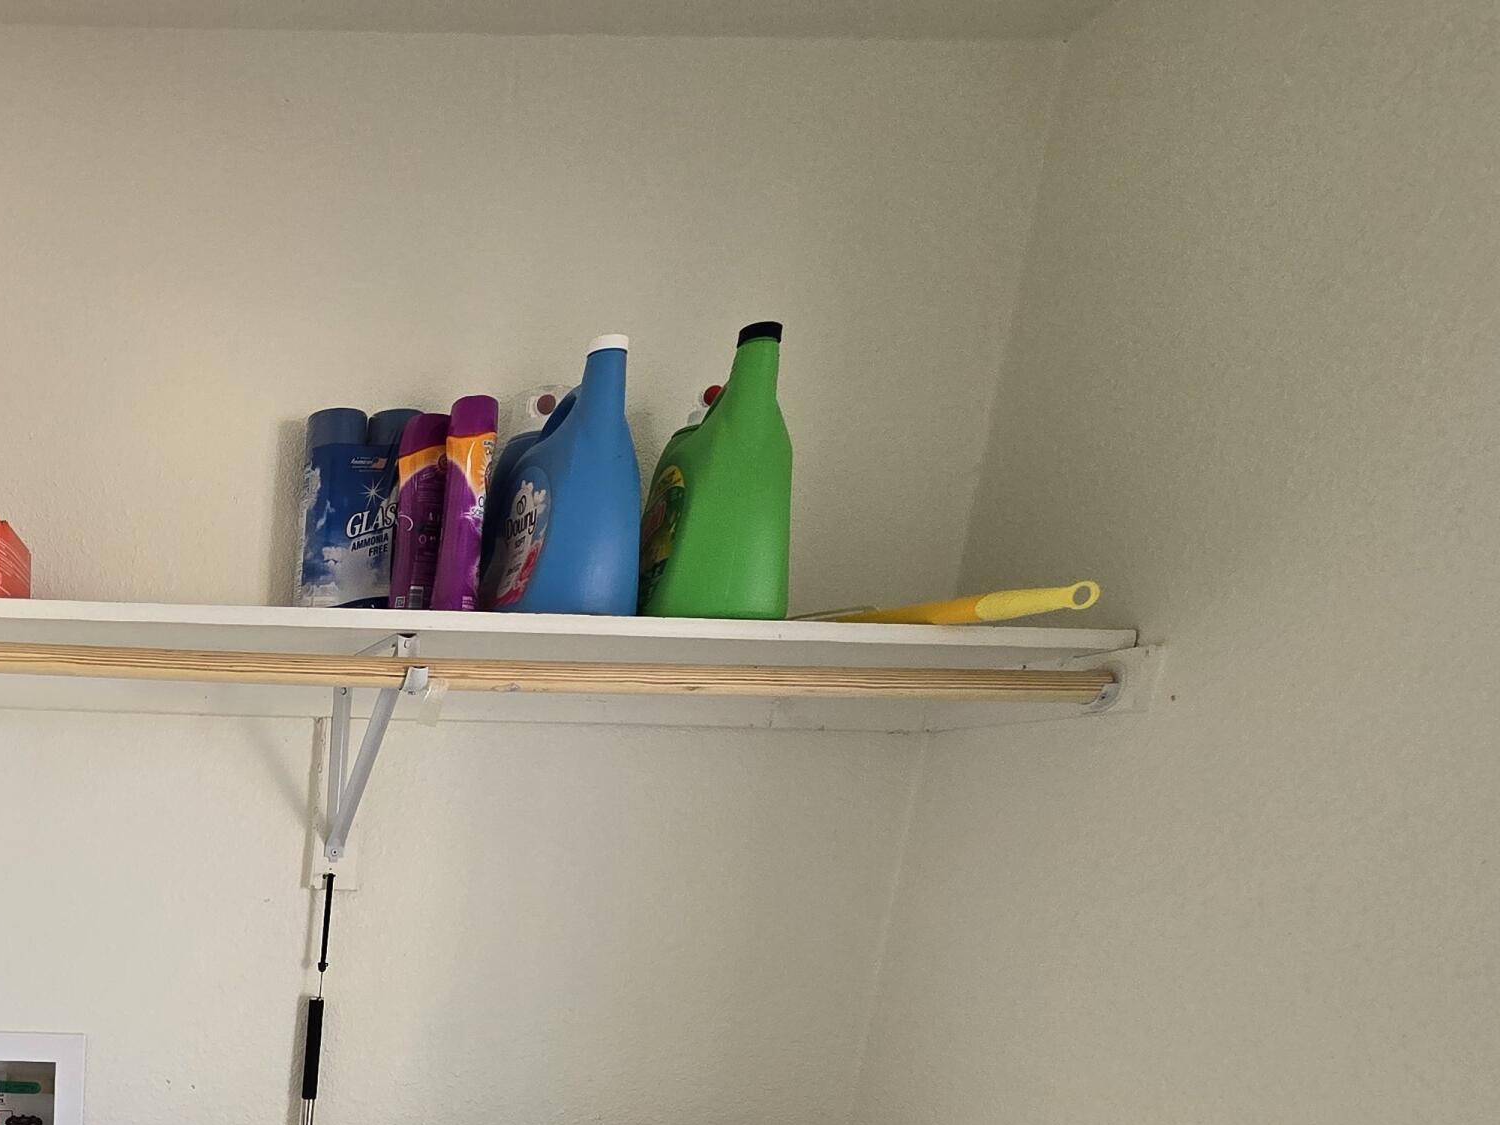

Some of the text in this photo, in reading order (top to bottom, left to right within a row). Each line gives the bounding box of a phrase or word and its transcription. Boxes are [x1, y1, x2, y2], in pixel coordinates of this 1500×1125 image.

[346, 503, 398, 539] GLAS
[506, 509, 537, 540] Downy
[350, 532, 389, 552] AMMONIA
[368, 543, 389, 557] FREE
